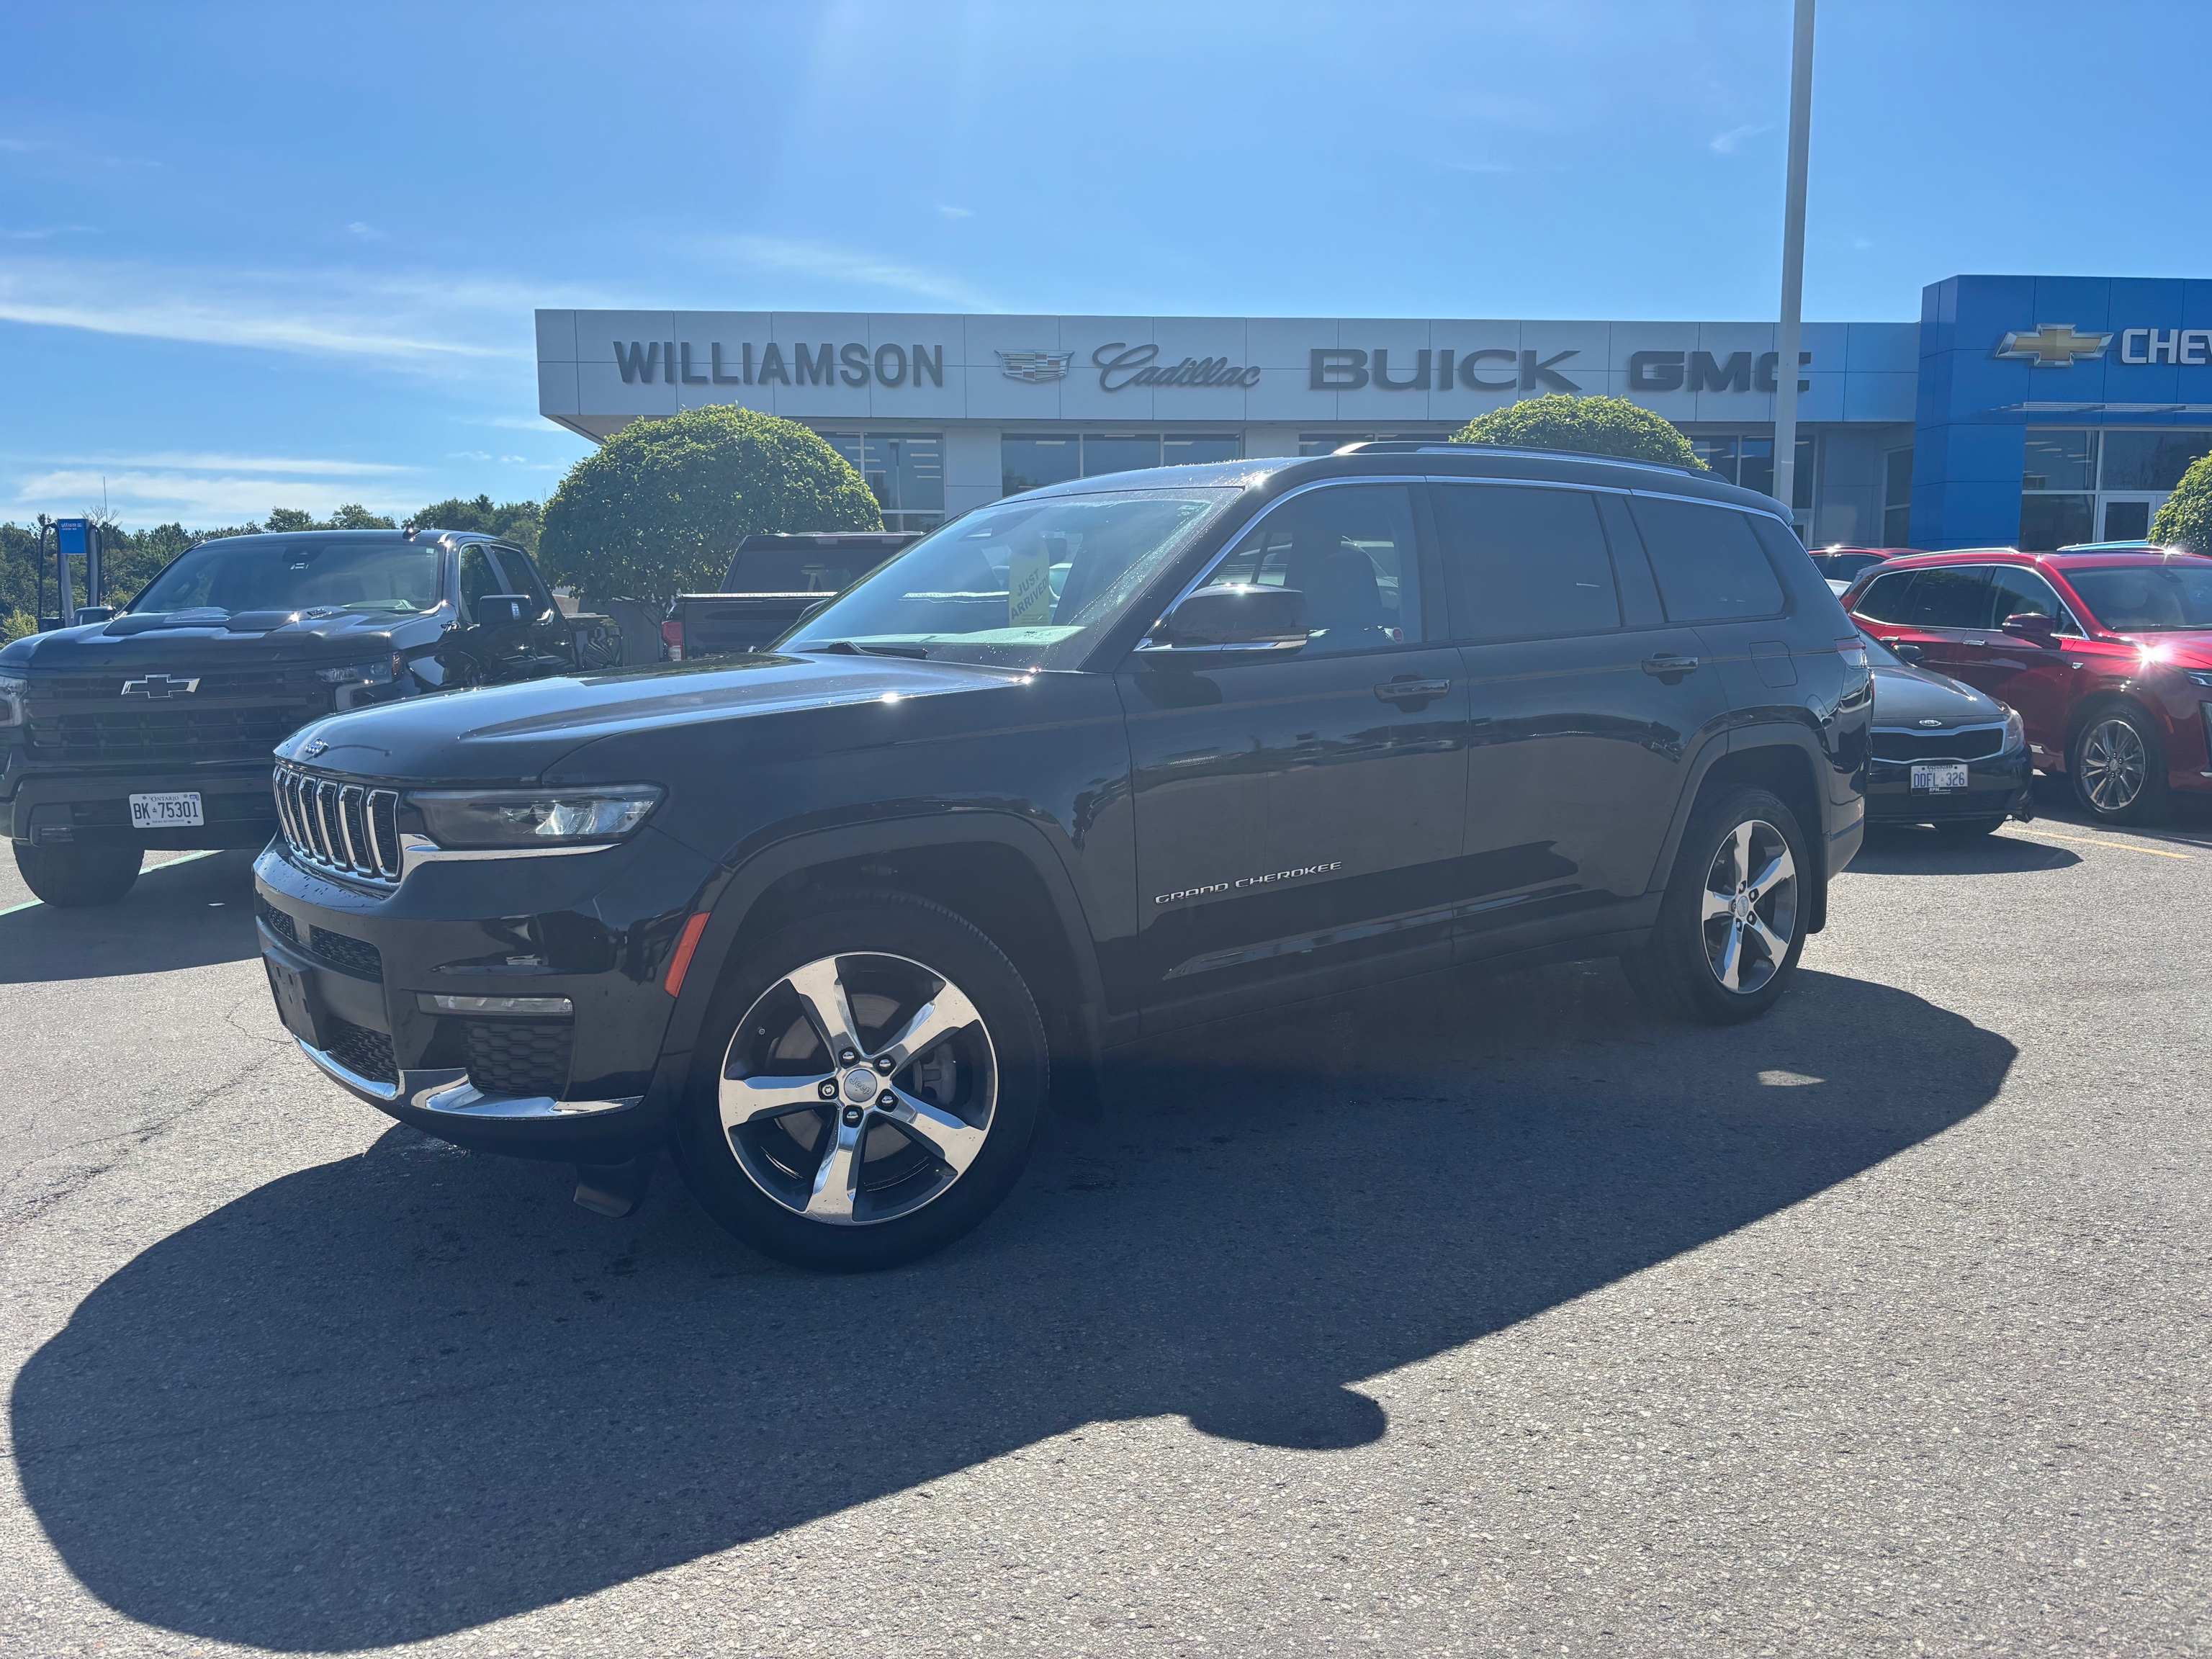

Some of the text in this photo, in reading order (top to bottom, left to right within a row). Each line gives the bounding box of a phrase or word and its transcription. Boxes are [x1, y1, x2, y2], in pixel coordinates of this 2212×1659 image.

[613, 341, 943, 387] WILLIAMSON
[2122, 328, 2212, 364] CHE
[1092, 343, 1261, 392] Cadillac
[1310, 349, 1581, 390] BUICK
[1630, 351, 1811, 392] GMC
[1017, 568, 1038, 597] JUST
[1914, 772, 1965, 788] DDFL 326
[133, 801, 199, 819] BK 75301
[1155, 861, 1342, 904] GRAND CHEROKEE
[850, 1077, 871, 1094] Jeep
